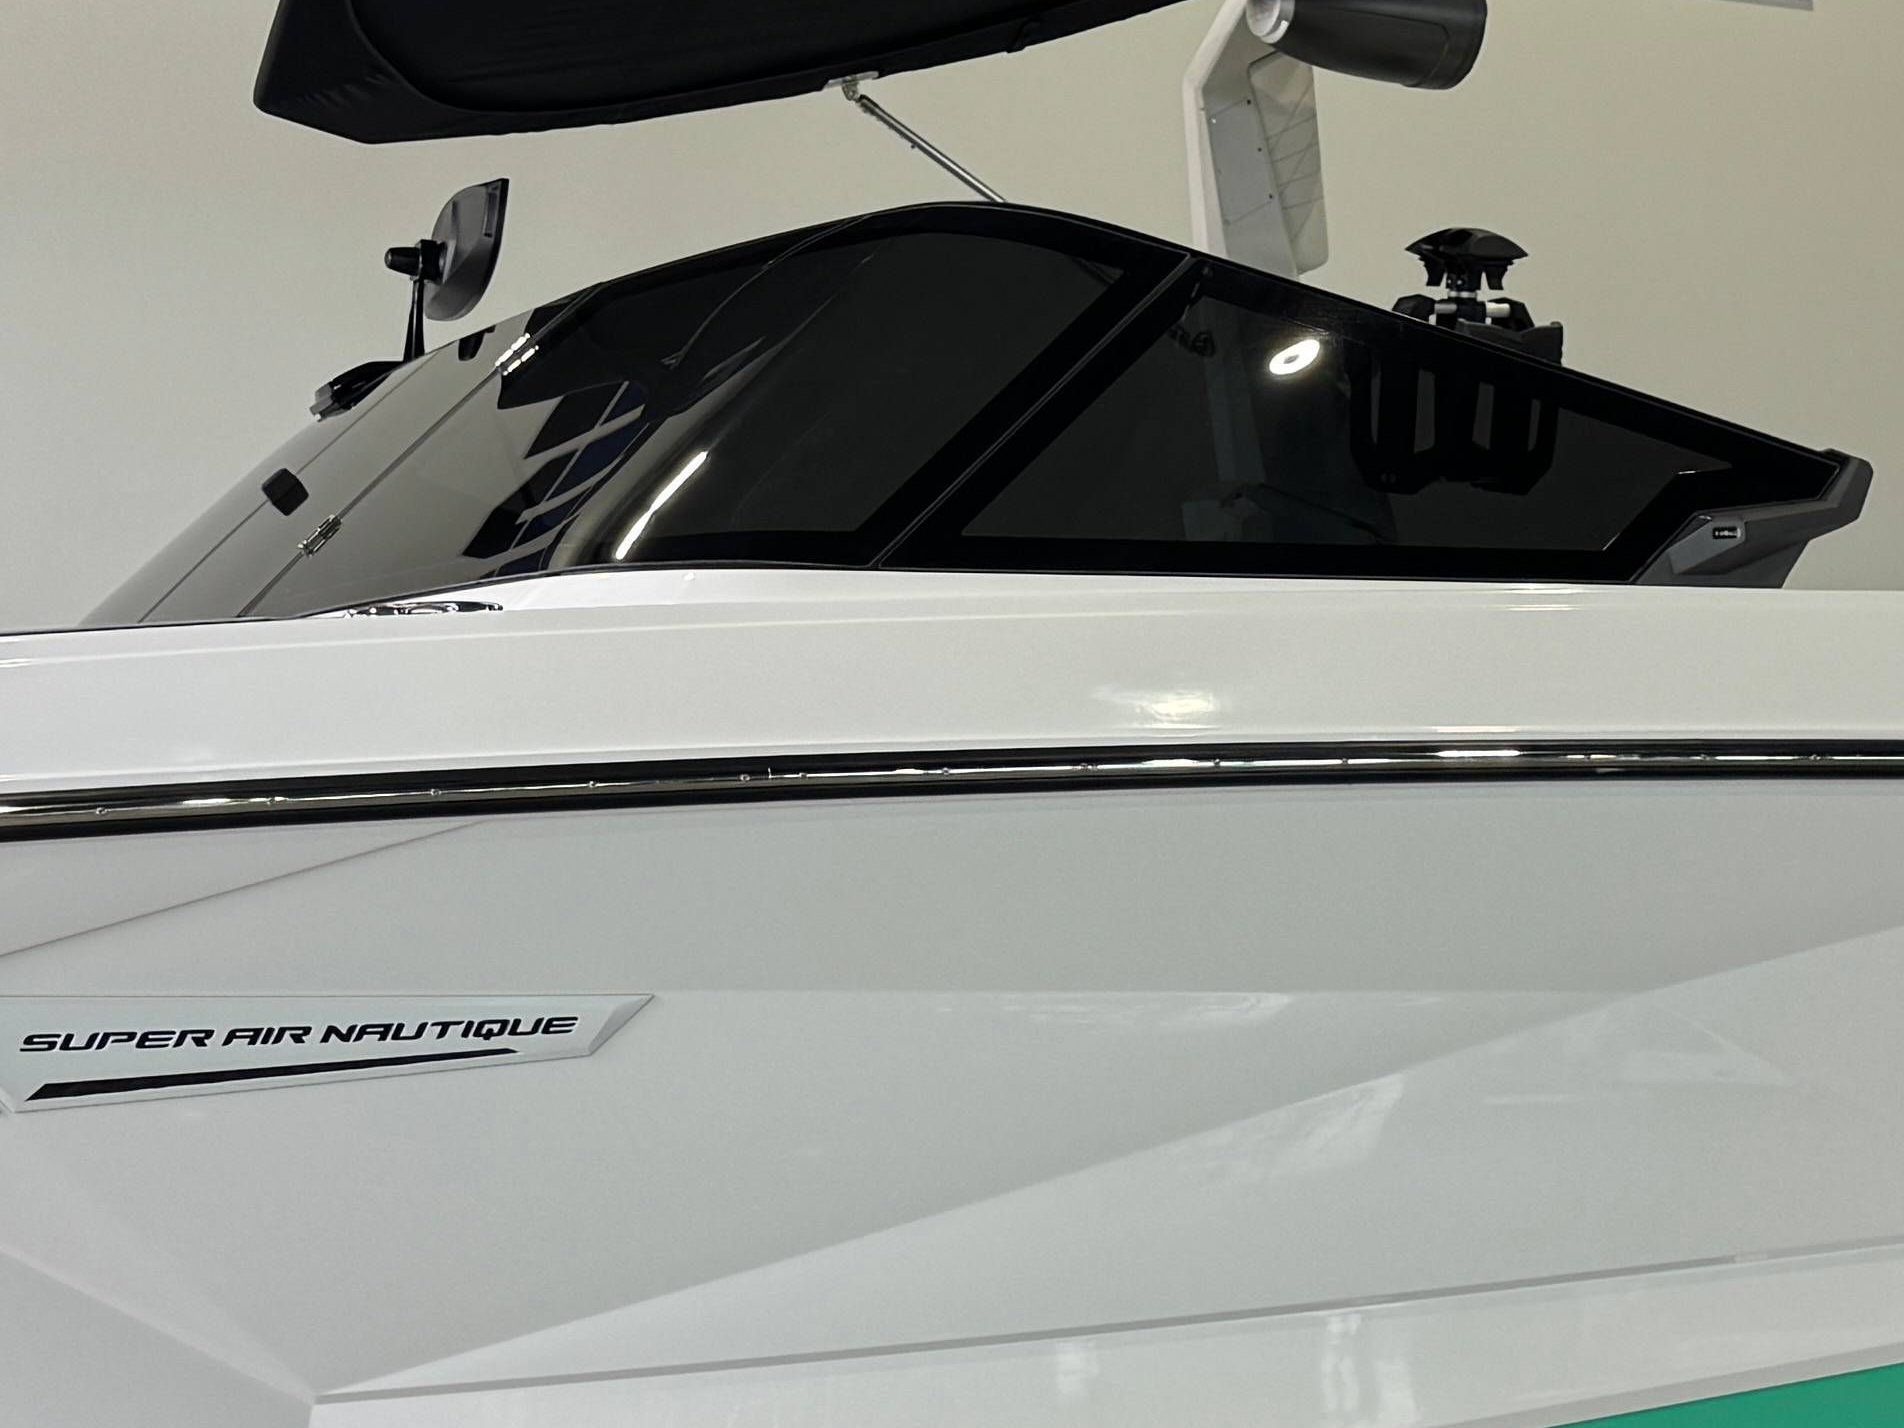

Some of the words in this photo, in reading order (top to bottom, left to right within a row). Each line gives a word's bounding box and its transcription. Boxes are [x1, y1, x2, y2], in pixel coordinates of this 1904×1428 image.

[19, 1028, 216, 1053] SUPER
[221, 1025, 313, 1047] AIR
[319, 1016, 579, 1044] NAUTIQUE
